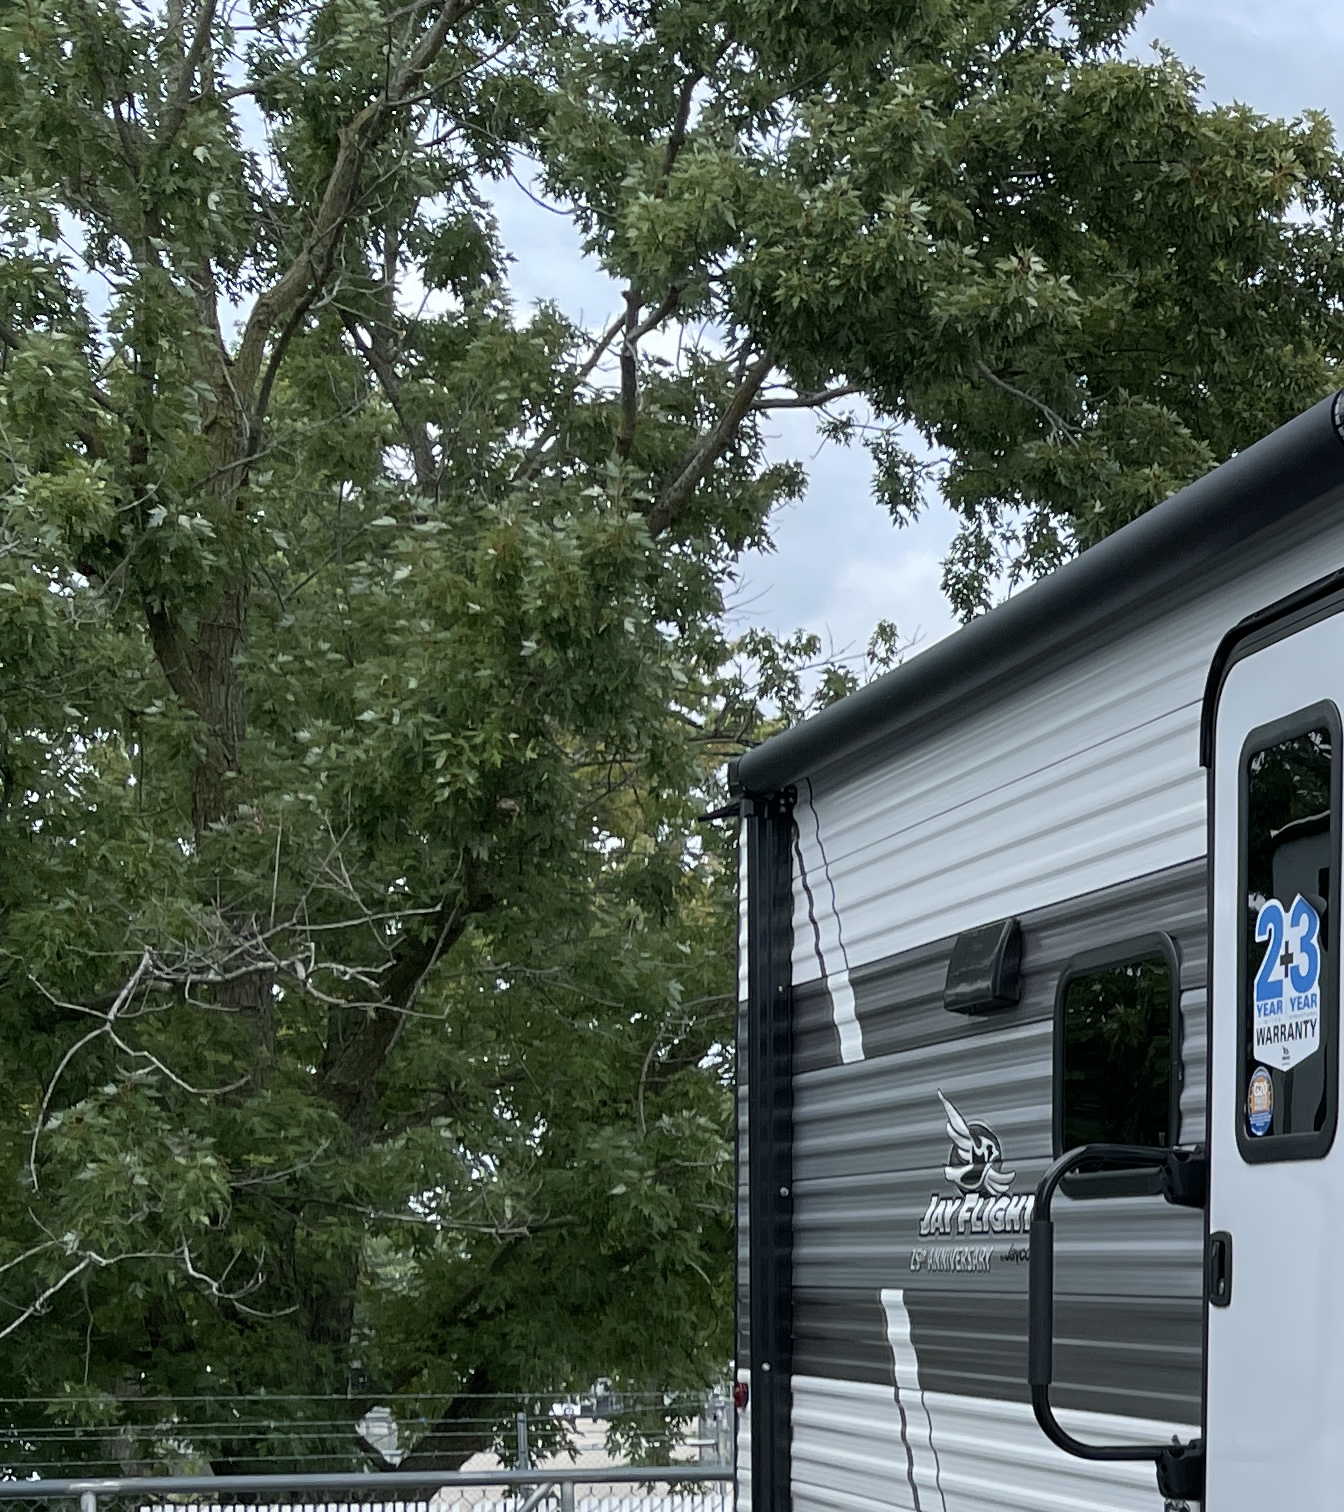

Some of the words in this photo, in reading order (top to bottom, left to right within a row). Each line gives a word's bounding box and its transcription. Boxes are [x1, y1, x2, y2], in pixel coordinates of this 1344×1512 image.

[1256, 999, 1284, 1019] YEAR
[1289, 992, 1318, 1012] YEAR
[1255, 1017, 1318, 1047] WARRANTY
[918, 1194, 961, 1237] JAY
[957, 1192, 1036, 1235] FLIGHT
[926, 1246, 995, 1273] ANNIVERSARY
